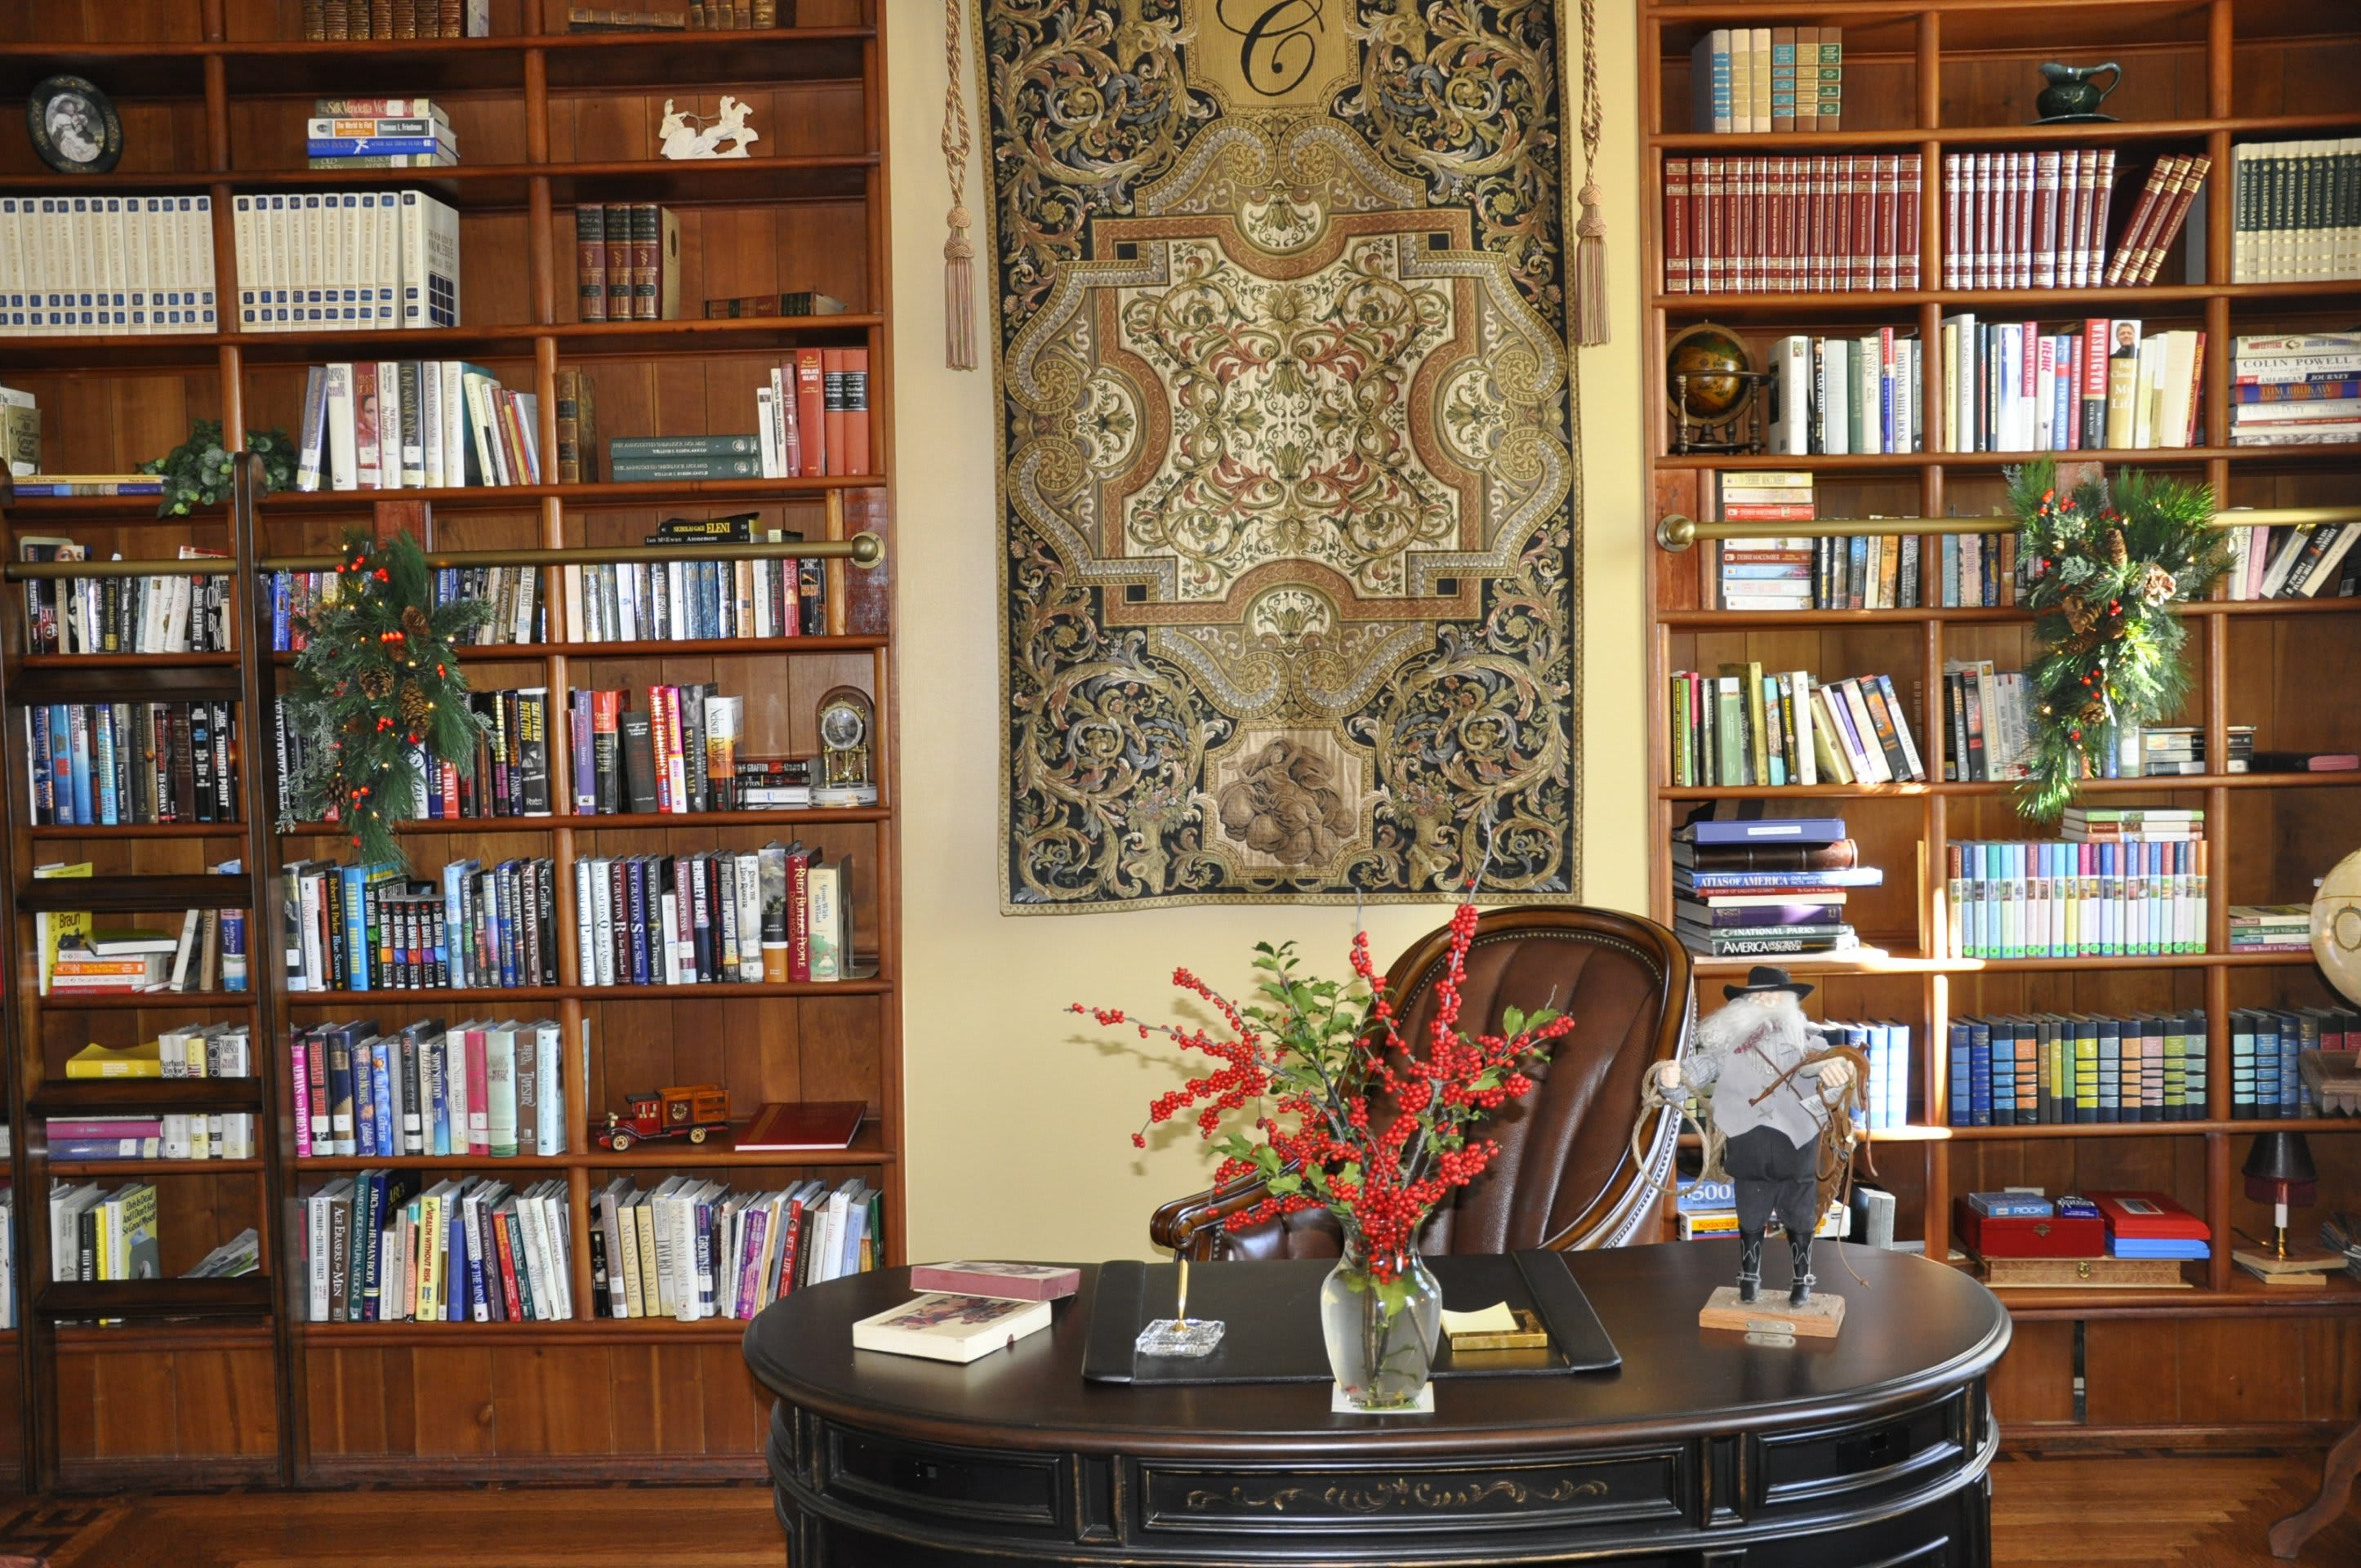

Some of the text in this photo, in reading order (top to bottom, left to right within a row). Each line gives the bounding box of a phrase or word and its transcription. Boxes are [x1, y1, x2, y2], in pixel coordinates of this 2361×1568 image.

[343, 101, 372, 114] Vendetta
[380, 123, 396, 131] Thomas
[2287, 174, 2296, 226] CHILDCRAFT
[2025, 326, 2035, 397] PRIMARY COLORS
[2091, 323, 2105, 390] WASHINGTON
[2243, 357, 2352, 368] COLIN POWELL
[401, 367, 417, 436] LOVE MONEY
[2261, 385, 2332, 395] TOM BROKAW
[2057, 381, 2066, 445] TIM RUSSERT
[706, 523, 731, 533] ELENI
[440, 571, 451, 593] FAMILY
[521, 581, 533, 608] FRANCIS
[519, 702, 532, 742] DETECTIVES
[532, 702, 541, 716] GREAT
[711, 708, 726, 768] Nelson DeMille
[216, 735, 229, 807] THUNDER POINT
[685, 728, 696, 795] WALLY LAMB
[158, 773, 167, 813] ED GORMAN
[443, 771, 454, 804] TRIAL
[612, 865, 620, 880] SUE
[648, 865, 656, 880] SUE
[1700, 876, 1789, 886] ATLAS OF AMERICA
[346, 883, 358, 920] STARDUST
[366, 891, 376, 926] SUE GRAFTON
[523, 868, 536, 932] SUE GRAFTON
[539, 869, 550, 918] Sue Grafton
[613, 883, 622, 920] GRAFTON
[630, 882, 639, 921] GRAFTON
[649, 881, 657, 920] GRAFTON
[692, 861, 706, 924] BENCHLEY BEAST
[59, 913, 80, 929] Braun
[434, 913, 443, 947] SUE GRAFTON
[513, 895, 521, 932] GRAFTON
[597, 920, 609, 929] Q
[613, 921, 626, 933] R
[630, 923, 644, 933] S
[648, 920, 661, 930] T
[1787, 926, 1815, 934] PARKS
[332, 935, 341, 952] Blue
[380, 914, 390, 947] SUE GRAFTON
[394, 915, 405, 948] SUE GRAFTON
[408, 915, 417, 949] SUE GRAFTON
[421, 915, 432, 948] SUE GRAFTON
[1722, 941, 1769, 953] AMERICA
[334, 953, 342, 980] Screen
[653, 945, 661, 976] Trespass
[797, 937, 807, 968] PEOPLE
[293, 1063, 308, 1146] ALWAYS FOREVER
[141, 1191, 154, 1205] Dead
[2014, 1207, 2043, 1215] ROOK
[122, 1220, 143, 1236] So Good
[123, 1213, 133, 1223] And
[334, 1206, 344, 1225] AGE
[1698, 1220, 1735, 1229] Kodacolor
[334, 1226, 345, 1261] ERASERS
[366, 1229, 376, 1285] HUMAN BODY
[424, 1237, 432, 1266] WITHOUT
[622, 1224, 635, 1265] MOON
[640, 1223, 652, 1263] MOON
[783, 1235, 794, 1275] SET LIFE
[352, 1267, 361, 1300] MEDICINE
[423, 1267, 431, 1283] RISK
[467, 1231, 483, 1304] EMPIRES OF THE MIND
[333, 1272, 344, 1297] MEN
